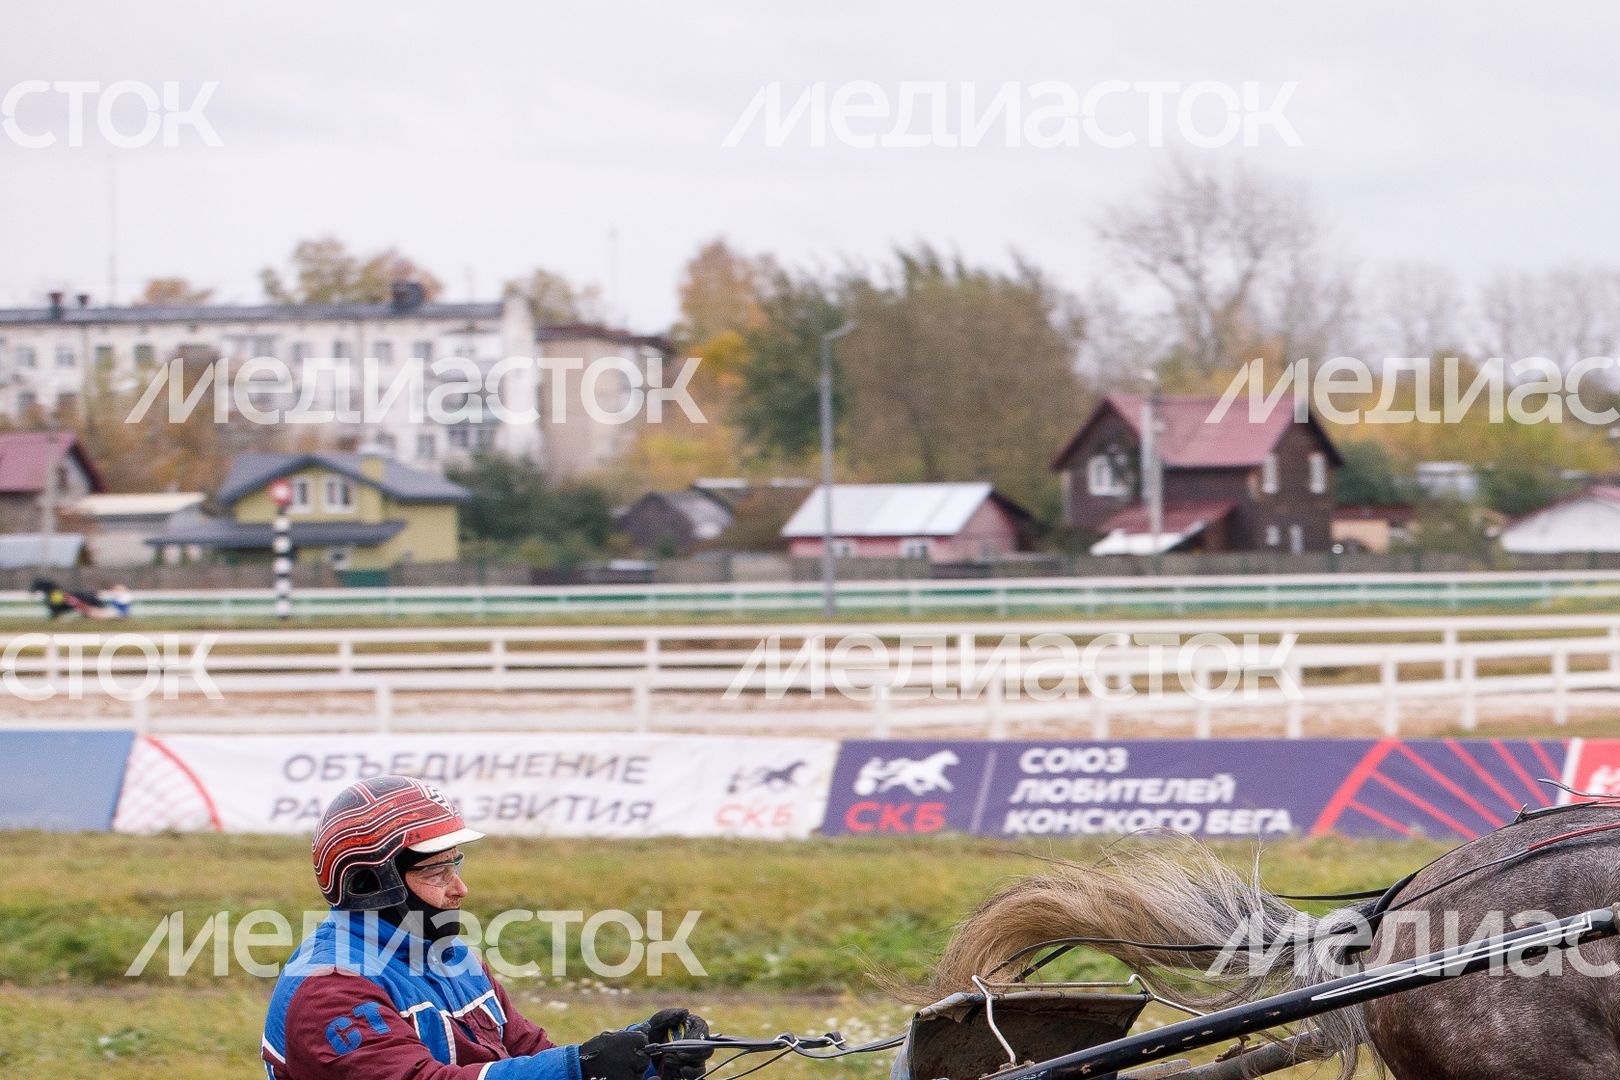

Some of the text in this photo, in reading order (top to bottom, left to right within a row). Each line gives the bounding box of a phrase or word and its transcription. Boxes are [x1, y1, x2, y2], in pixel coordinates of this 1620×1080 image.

[283, 752, 652, 785] ОБЪЕДИНЕНИЕ
[1019, 747, 1130, 773] СОЮЗ
[1009, 773, 1237, 804] ЛЮБИТЕЛЕЙ
[714, 802, 796, 828] СКБ
[843, 801, 948, 834] СКБ
[1003, 808, 1294, 836] КОНСКОГО БЕГА
